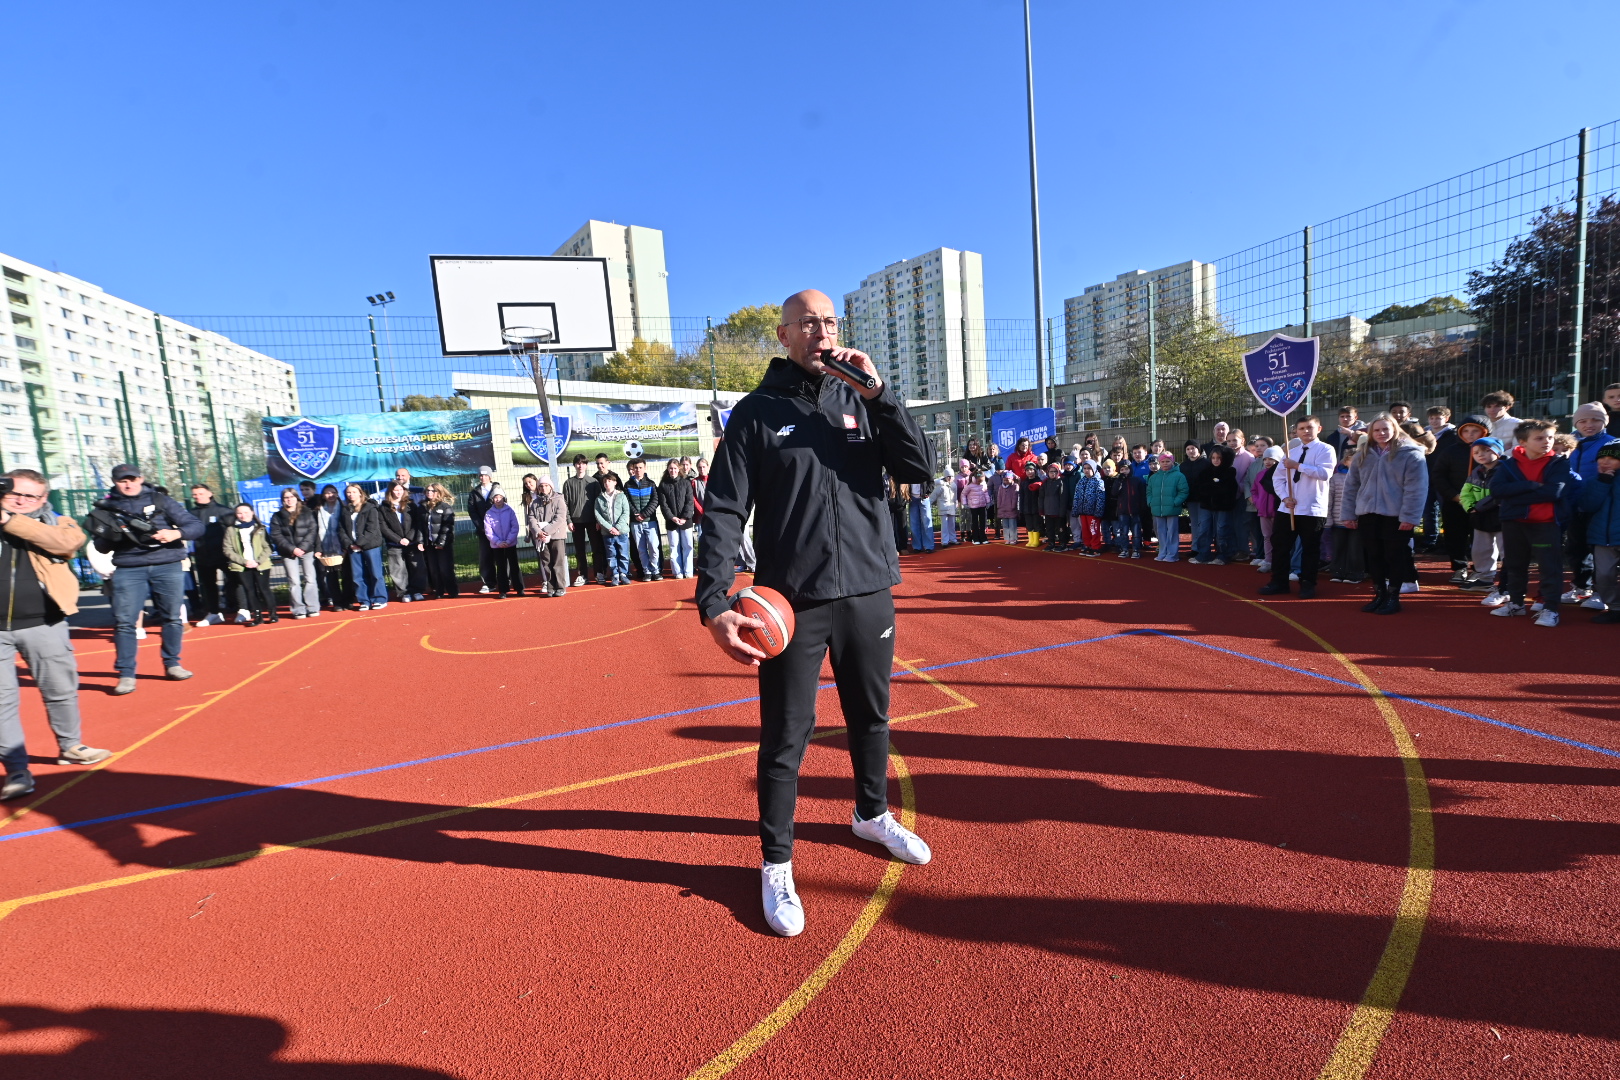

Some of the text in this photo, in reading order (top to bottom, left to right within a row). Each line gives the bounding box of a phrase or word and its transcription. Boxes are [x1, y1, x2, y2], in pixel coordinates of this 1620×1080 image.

[1268, 350, 1290, 371] 51
[600, 432, 639, 442] wszystko
[639, 431, 667, 441] jasne!
[776, 424, 796, 436] 4F
[1019, 425, 1048, 438] AKTYWNA
[1023, 431, 1048, 442] KOŁA
[297, 431, 317, 444] 51
[1000, 430, 1014, 447] AS
[365, 441, 455, 454] i wszystko jasne!
[880, 626, 893, 639] 4F
